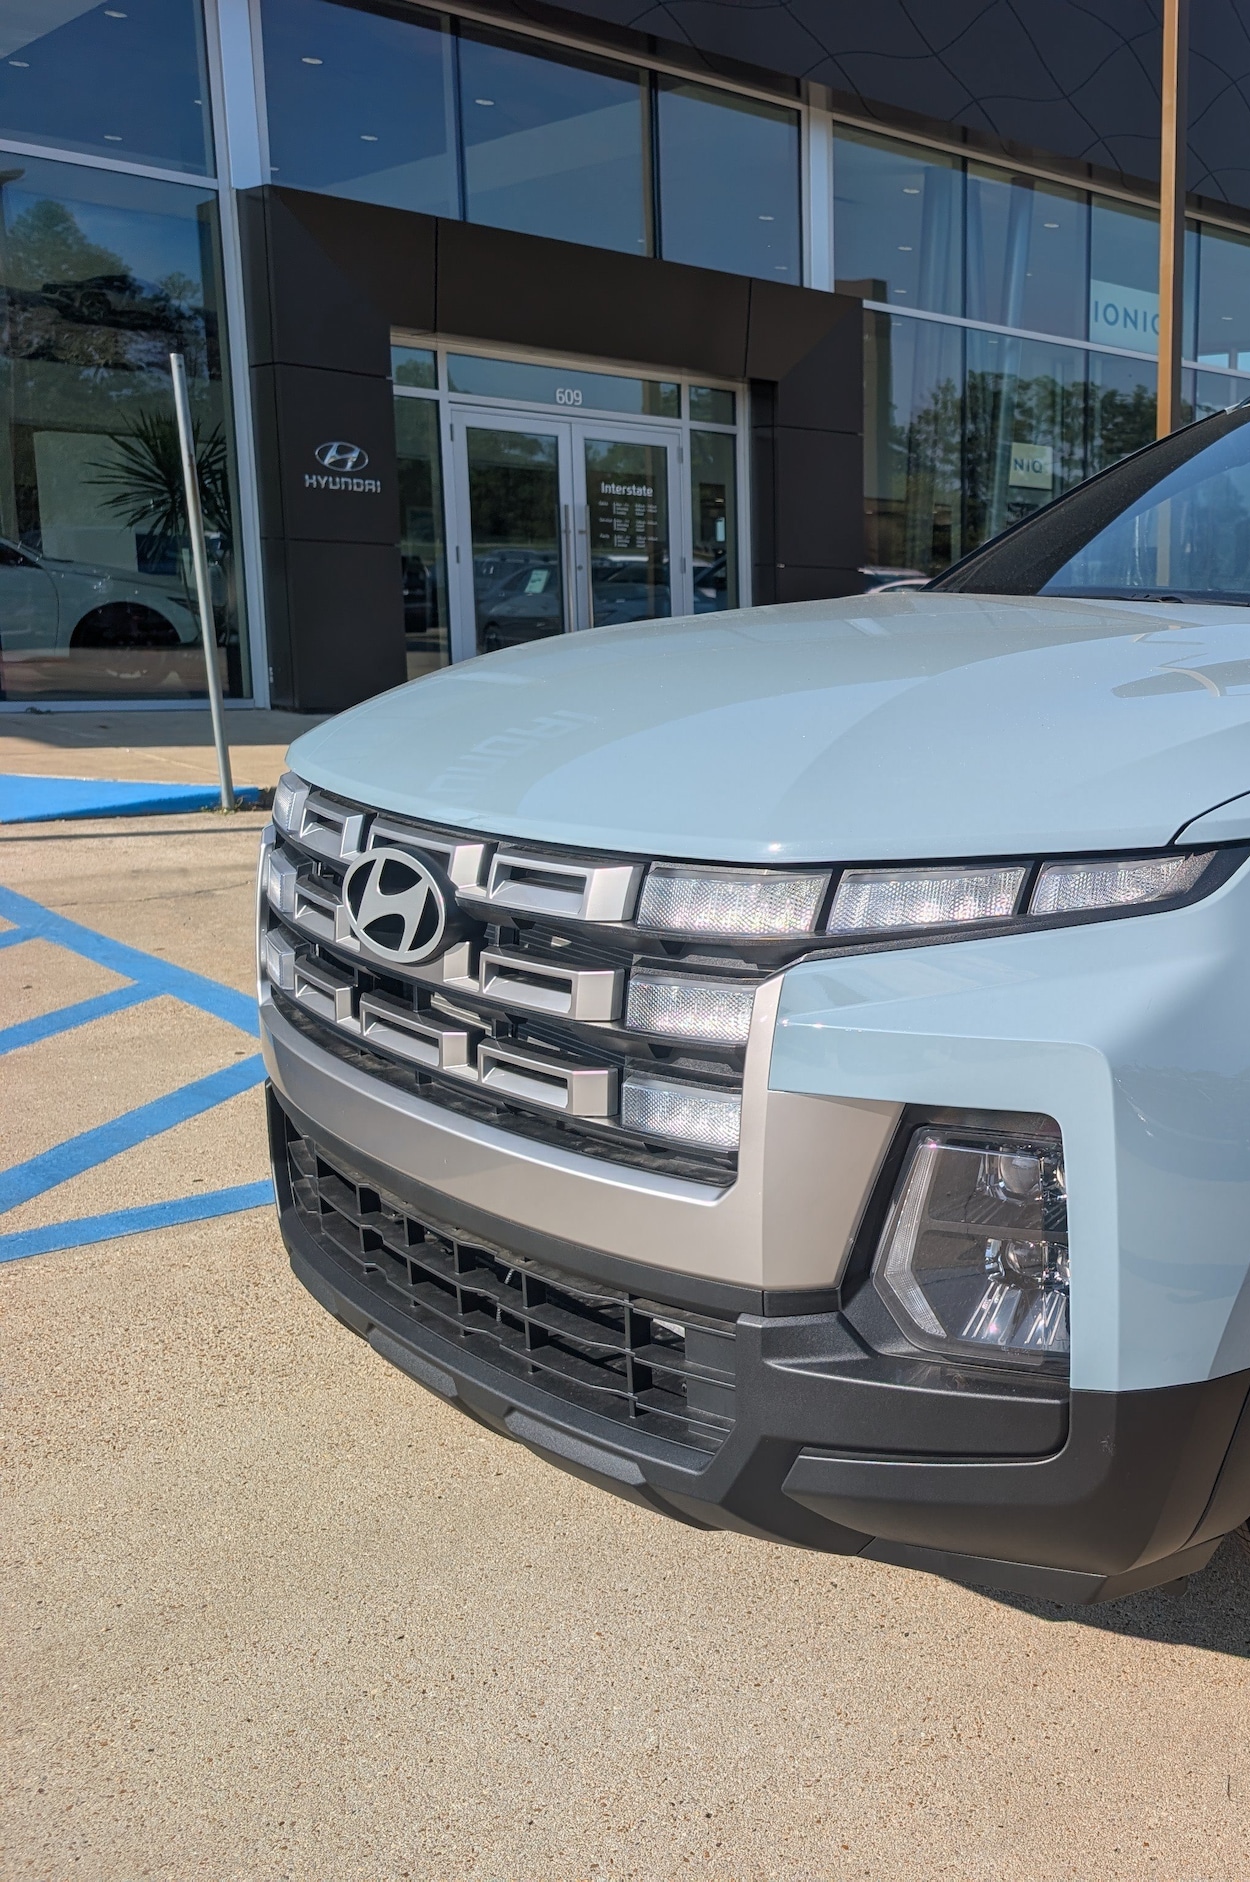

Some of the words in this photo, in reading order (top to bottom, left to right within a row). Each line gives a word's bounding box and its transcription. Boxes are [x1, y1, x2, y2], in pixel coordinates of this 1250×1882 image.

[555, 388, 583, 406] 609
[305, 474, 381, 494] HYUNDAI
[601, 481, 654, 497] Interstate
